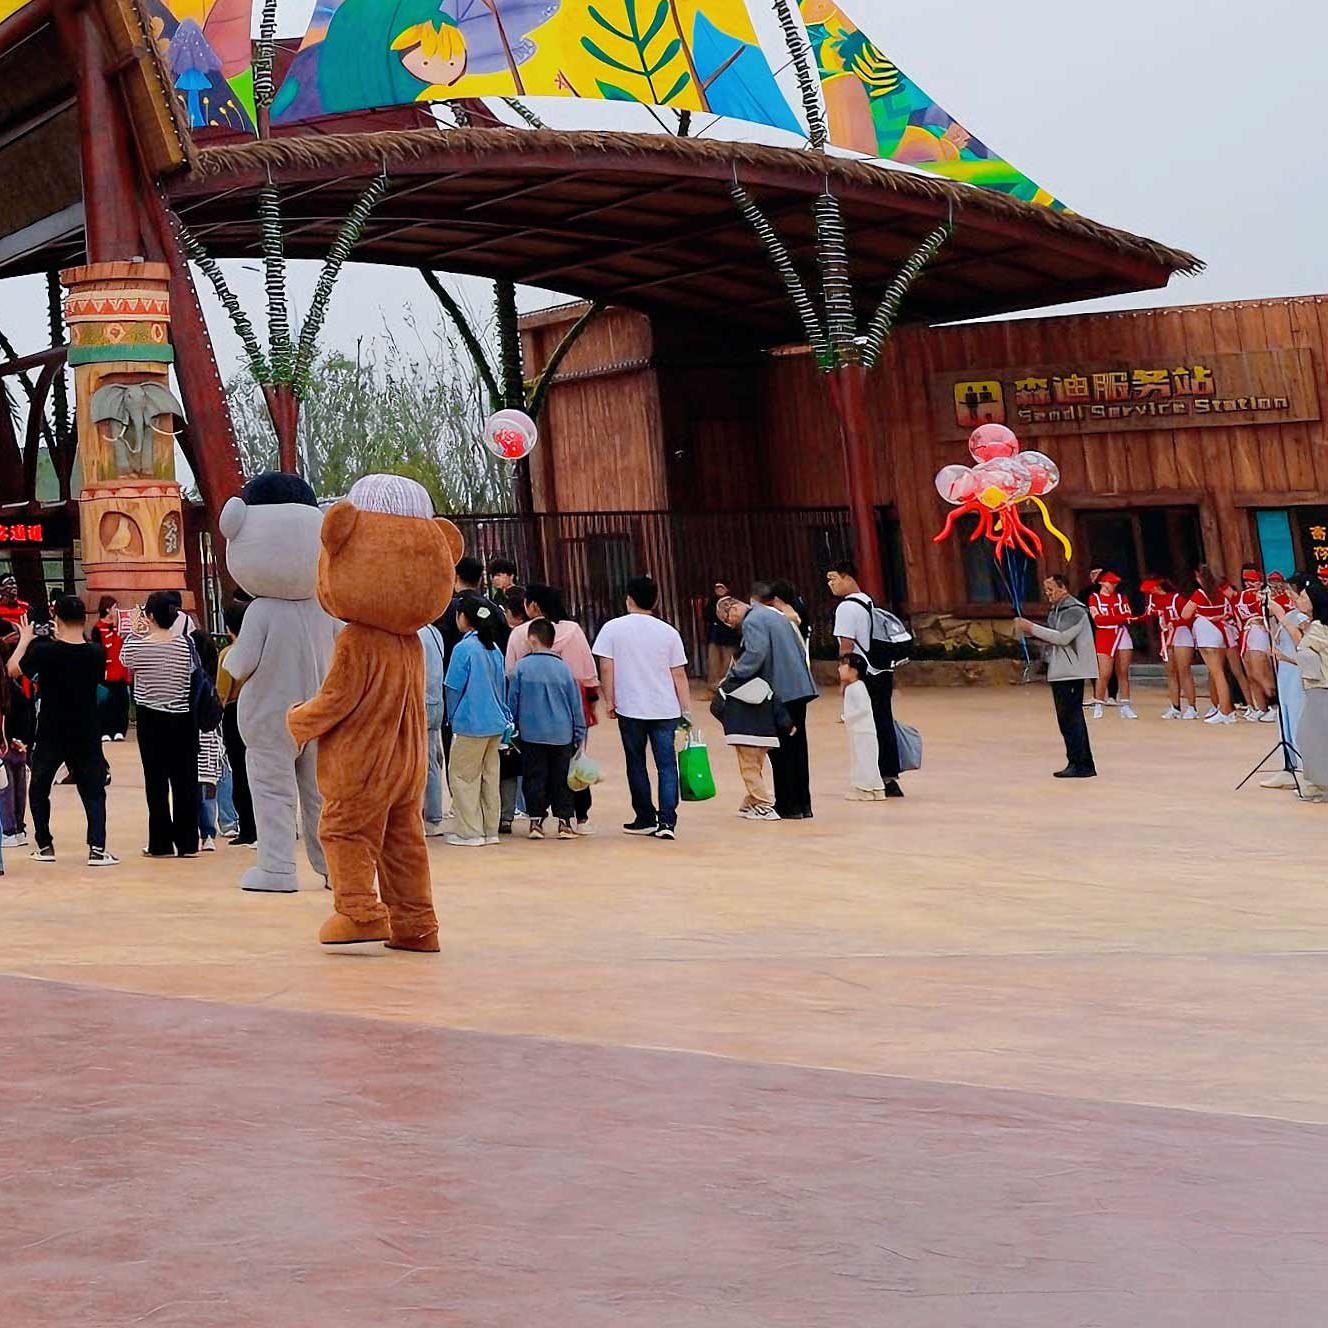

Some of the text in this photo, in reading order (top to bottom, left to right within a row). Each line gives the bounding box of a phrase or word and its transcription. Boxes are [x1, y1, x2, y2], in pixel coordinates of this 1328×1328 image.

[1015, 366, 1216, 406] 森迪服务站
[1091, 400, 1186, 420] Service
[1194, 396, 1289, 415] Station
